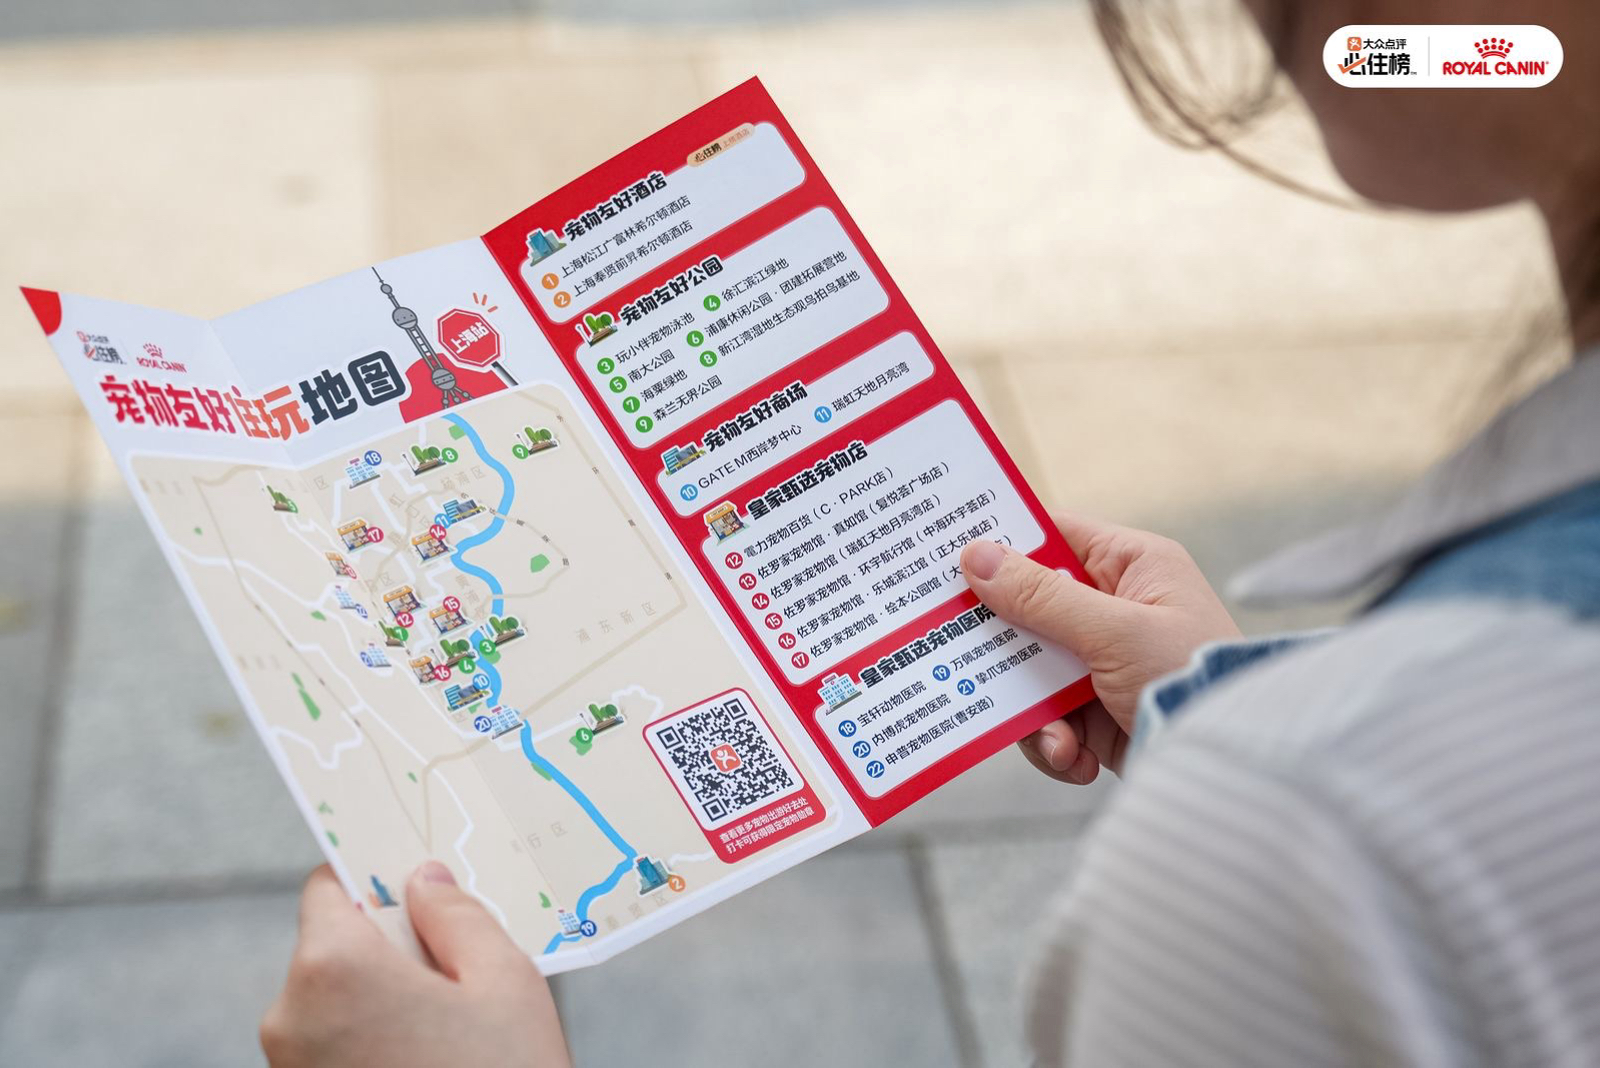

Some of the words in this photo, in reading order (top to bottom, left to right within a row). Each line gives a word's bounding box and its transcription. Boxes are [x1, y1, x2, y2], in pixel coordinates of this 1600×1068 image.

[564, 171, 667, 241] 宠物友好酒店
[560, 195, 691, 278] 上海松江广富林希尔顿酒店
[574, 220, 694, 298] 上海奉贤前昇希尔顿酒店
[620, 257, 724, 326] 宠物友好公园
[721, 257, 789, 301] 徐汇滨江绿地
[450, 322, 490, 354] 上海站
[717, 269, 860, 357] 新江湾湿地生态观鸟拍鸟基地
[615, 312, 695, 365] 玩小伴宠物泳池
[628, 349, 675, 384] 南大公园
[640, 368, 688, 403] 海粟绿地
[831, 360, 911, 412] 瑞虹天地月亮湾
[99, 350, 406, 441] 宠物友好住玩地图
[653, 375, 722, 422] 森兰无界公园
[703, 382, 808, 453] 宠物友好商场
[698, 461, 735, 489] GATE
[747, 441, 868, 521] 皇家甄选宠物店
[950, 627, 1018, 672] 万佩宠物医院
[975, 642, 1043, 686] 挚爪宠物医院
[857, 680, 927, 728] 宝轩动物医院
[871, 693, 951, 747] 内博虎宠物医院
[720, 796, 808, 843] 查看更多宠物出游好去处
[726, 806, 815, 854] 打卡可获得限定宠物勋章
